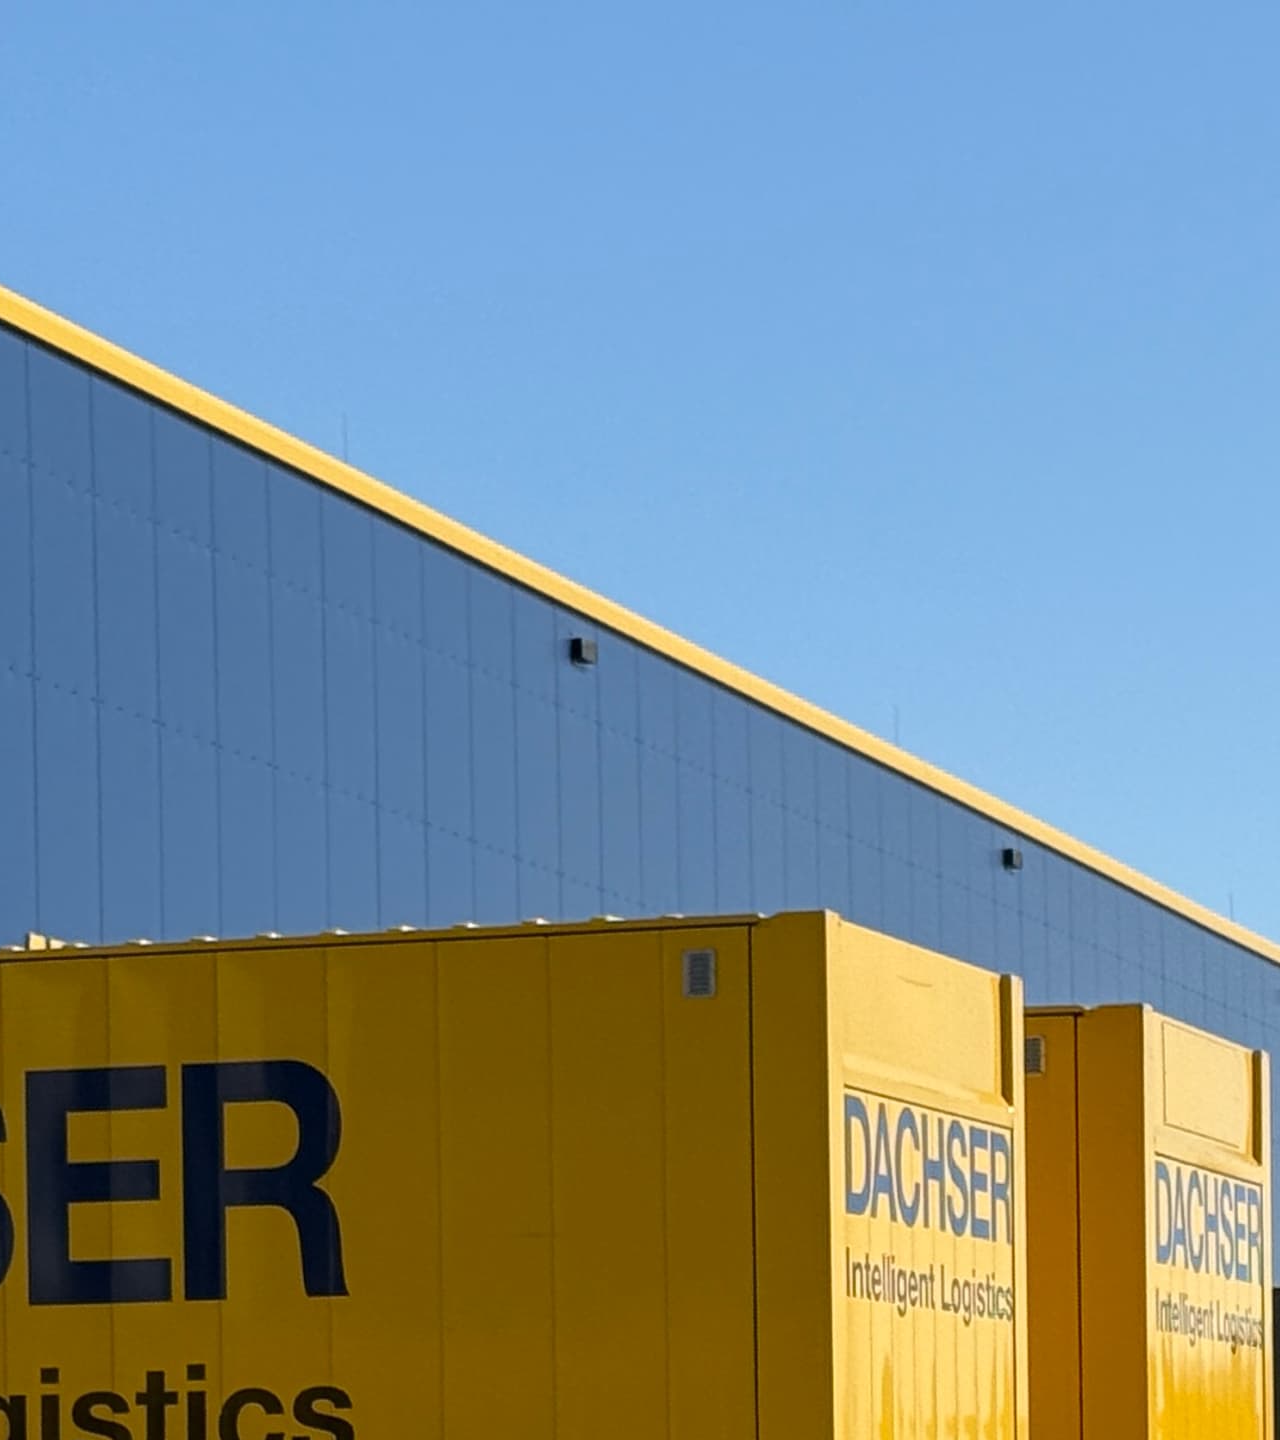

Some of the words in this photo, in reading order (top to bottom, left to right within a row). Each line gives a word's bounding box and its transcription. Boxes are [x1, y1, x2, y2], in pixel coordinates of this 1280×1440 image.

[844, 1093, 1012, 1245] DACHSER
[1155, 1160, 1263, 1285] DACHSER
[846, 1246, 936, 1318] Intelligent
[941, 1264, 1013, 1327] Logistics
[1156, 1287, 1215, 1348] Intelligent
[1217, 1300, 1264, 1355] Logistics
